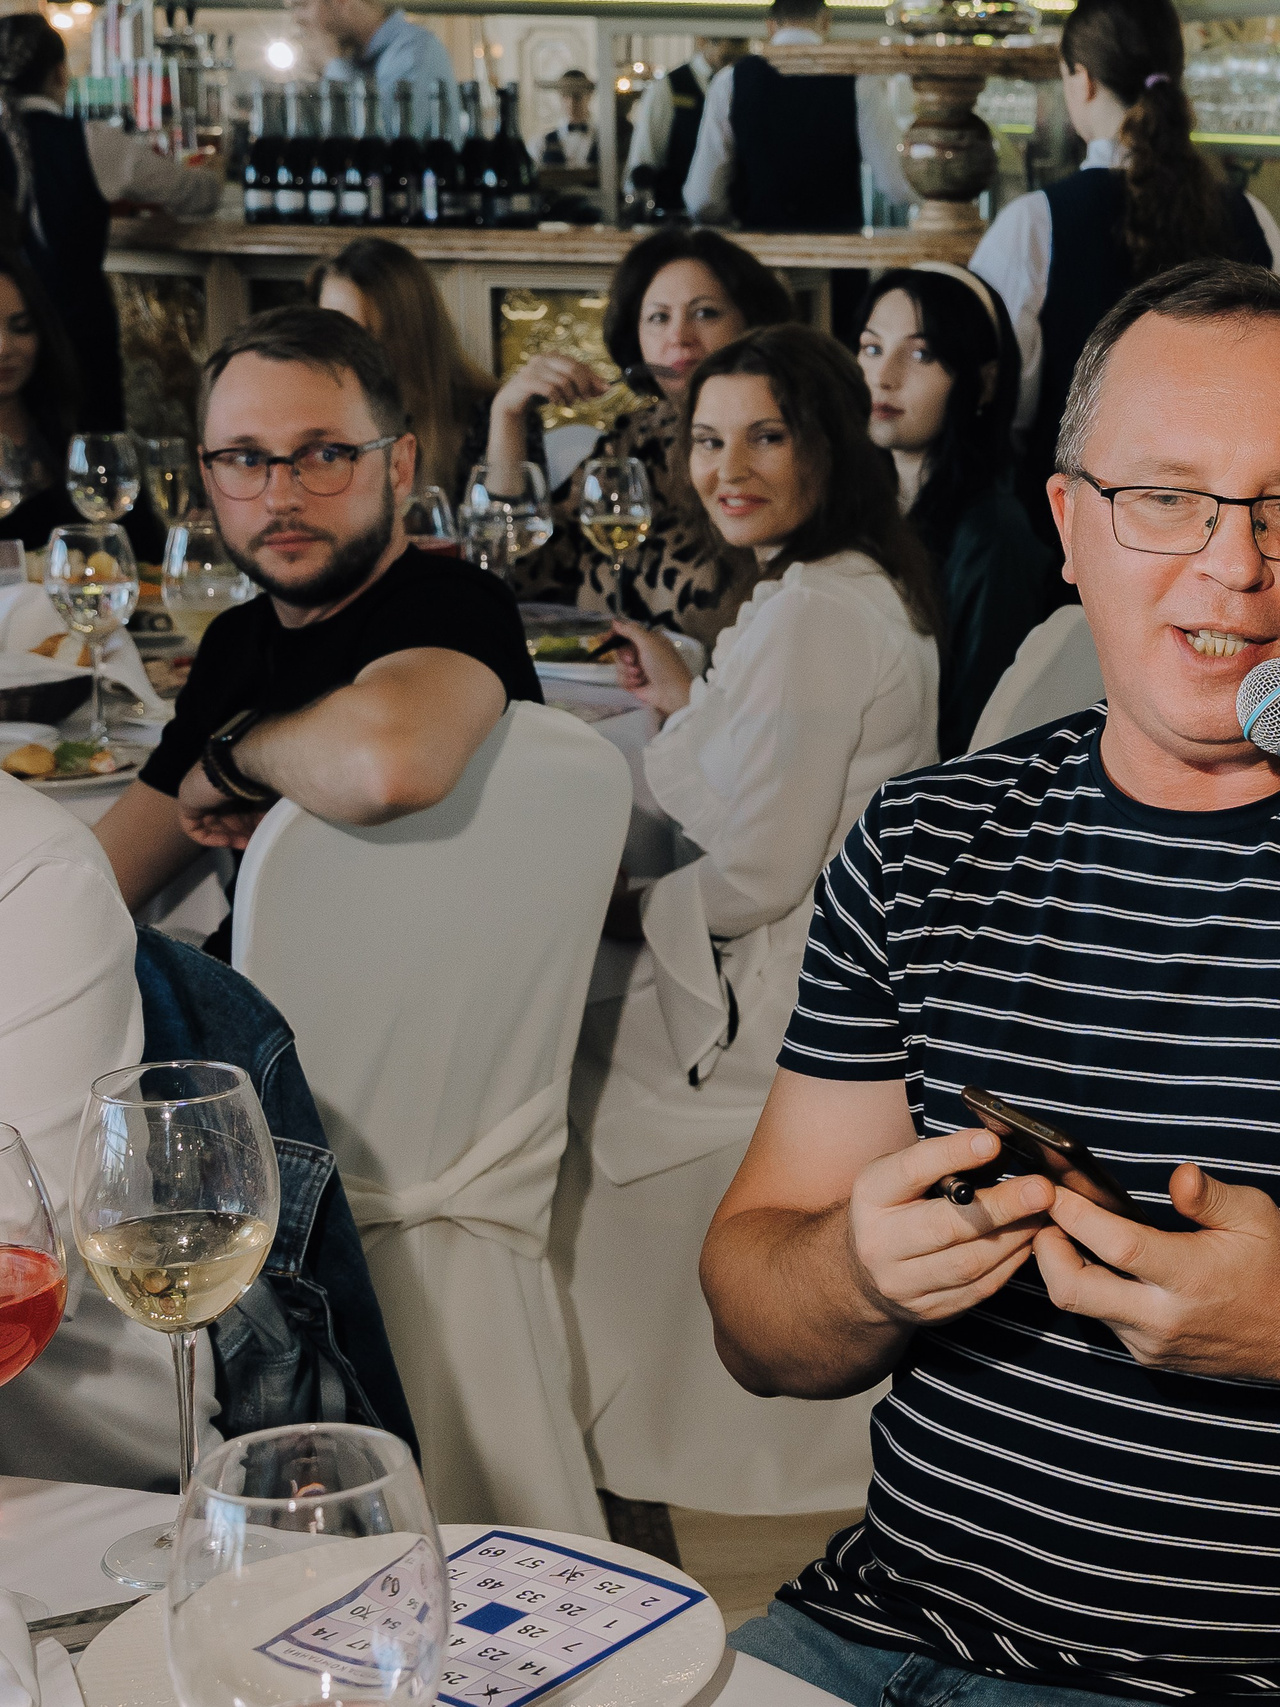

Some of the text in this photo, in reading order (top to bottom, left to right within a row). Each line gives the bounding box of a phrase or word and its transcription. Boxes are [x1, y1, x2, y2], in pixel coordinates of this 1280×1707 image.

[478, 1546, 506, 1558] 69
[514, 1557, 545, 1569] 57
[476, 1577, 505, 1590] 48
[594, 1581, 625, 1595] 25
[515, 1589, 546, 1604] 33
[640, 1596, 660, 1607] 2
[555, 1602, 587, 1617] 26
[381, 1617, 402, 1631] 54
[602, 1619, 618, 1629] 1
[310, 1627, 339, 1641] 74
[517, 1624, 549, 1639] 28
[477, 1646, 510, 1662] 23
[561, 1642, 583, 1653] 7
[517, 1661, 547, 1676] 14
